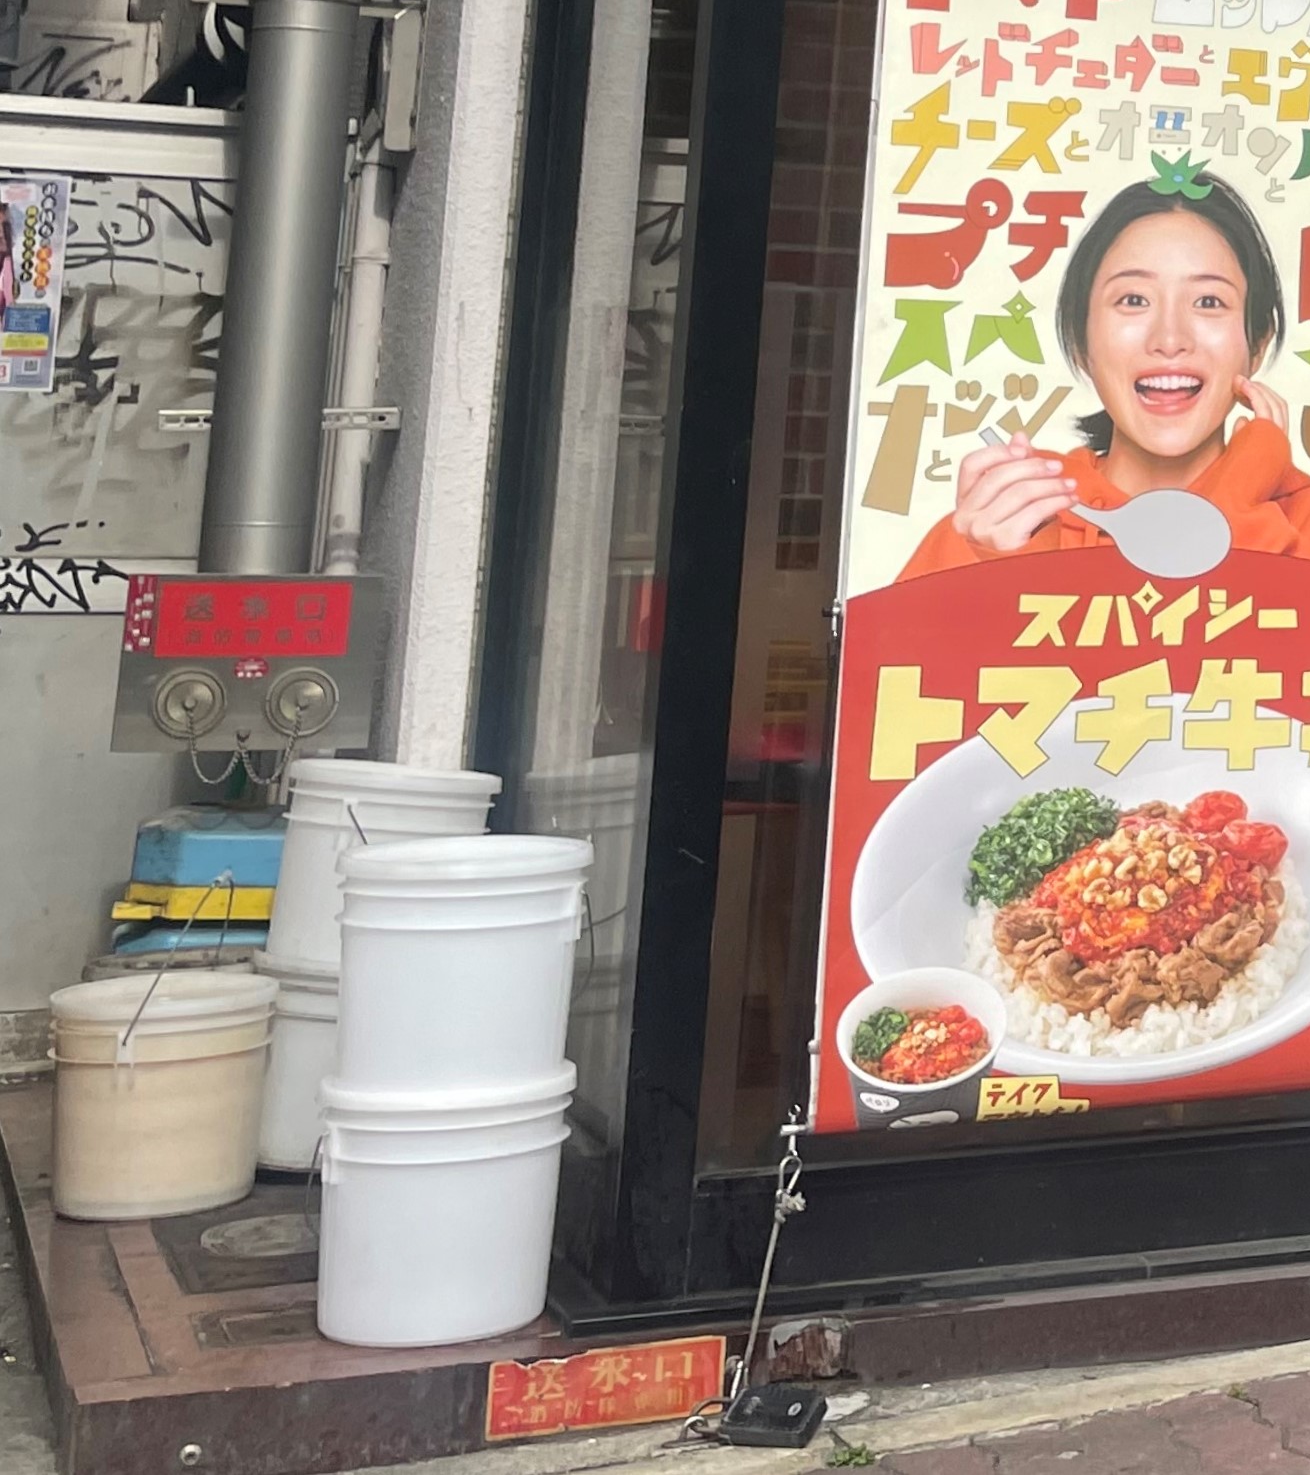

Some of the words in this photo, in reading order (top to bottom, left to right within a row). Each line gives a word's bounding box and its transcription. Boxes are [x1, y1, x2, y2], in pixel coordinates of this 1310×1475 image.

[1012, 581, 1298, 647] スパイシー
[986, 1082, 1053, 1107] テイク
